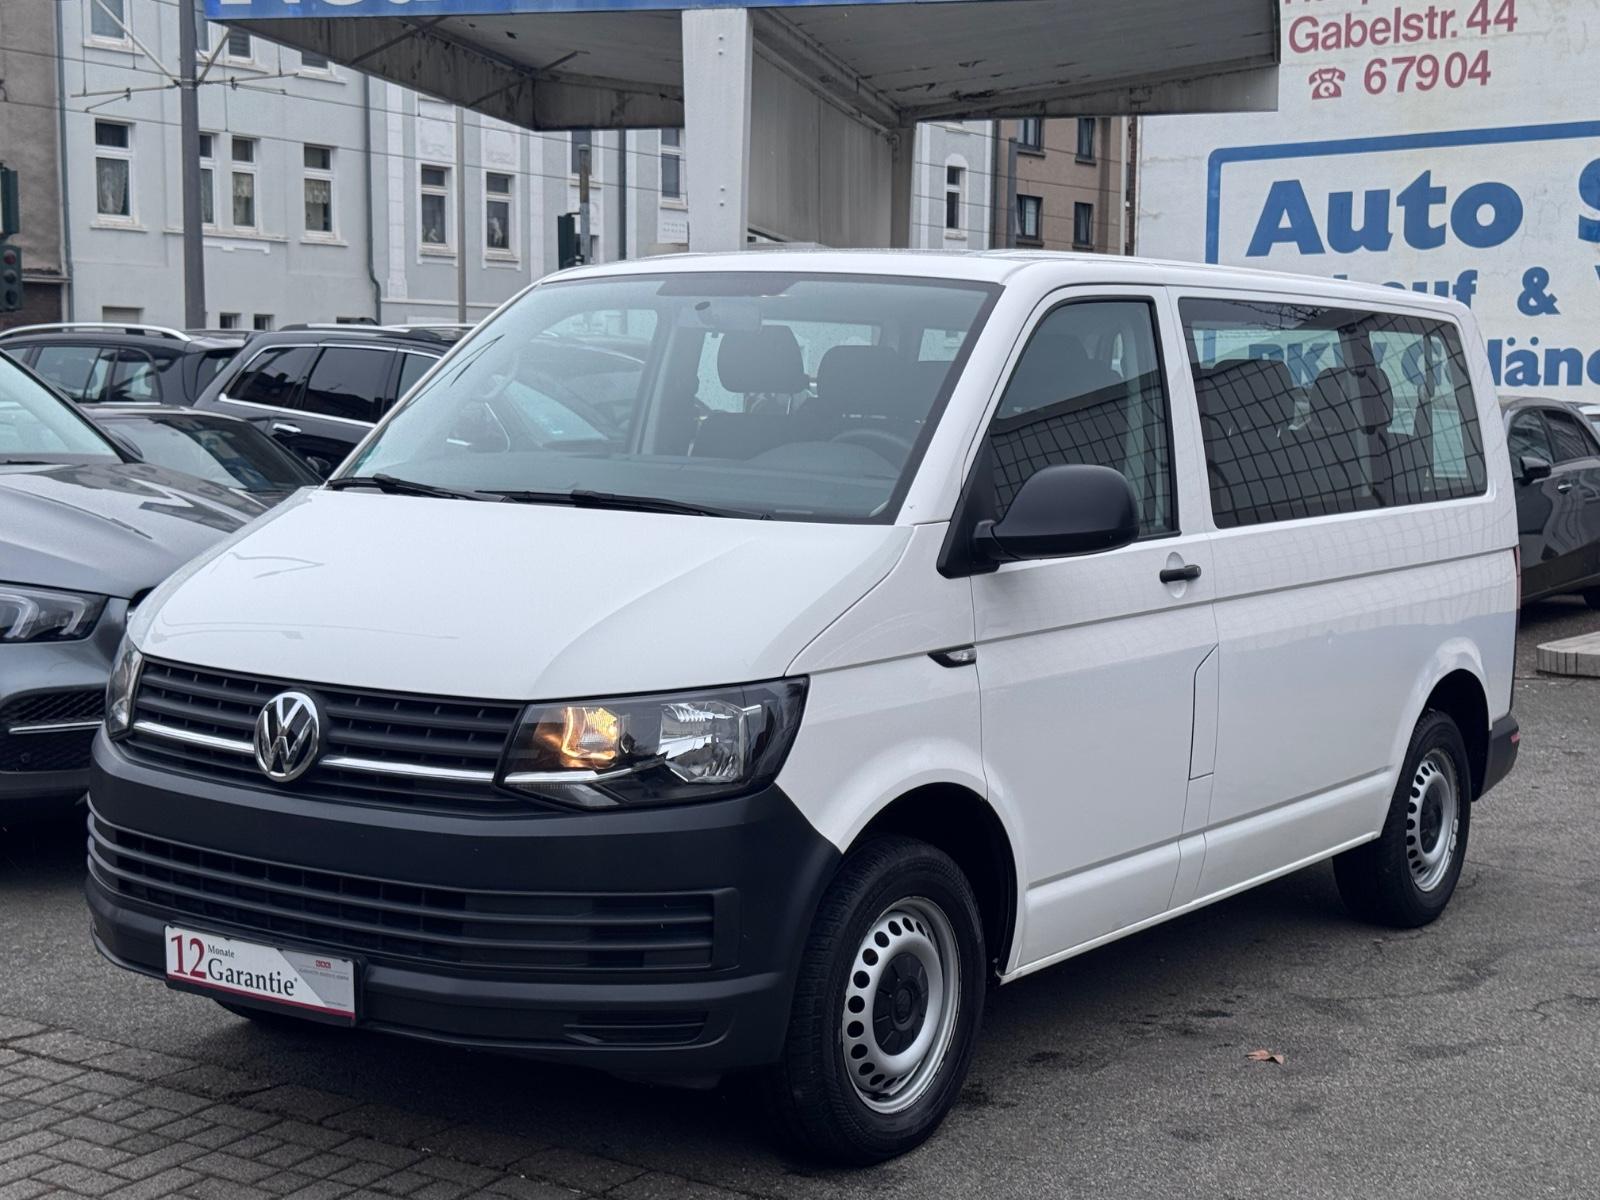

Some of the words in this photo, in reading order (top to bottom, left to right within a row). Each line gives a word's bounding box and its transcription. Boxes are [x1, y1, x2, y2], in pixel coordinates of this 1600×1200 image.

[1288, 5, 1458, 54] Gabelstr.
[1466, 0, 1518, 35] 44
[1363, 50, 1492, 95] 67904
[1245, 169, 1524, 257] Auto
[1517, 266, 1561, 317] &
[170, 934, 208, 980] 12
[207, 943, 235, 959] Monate
